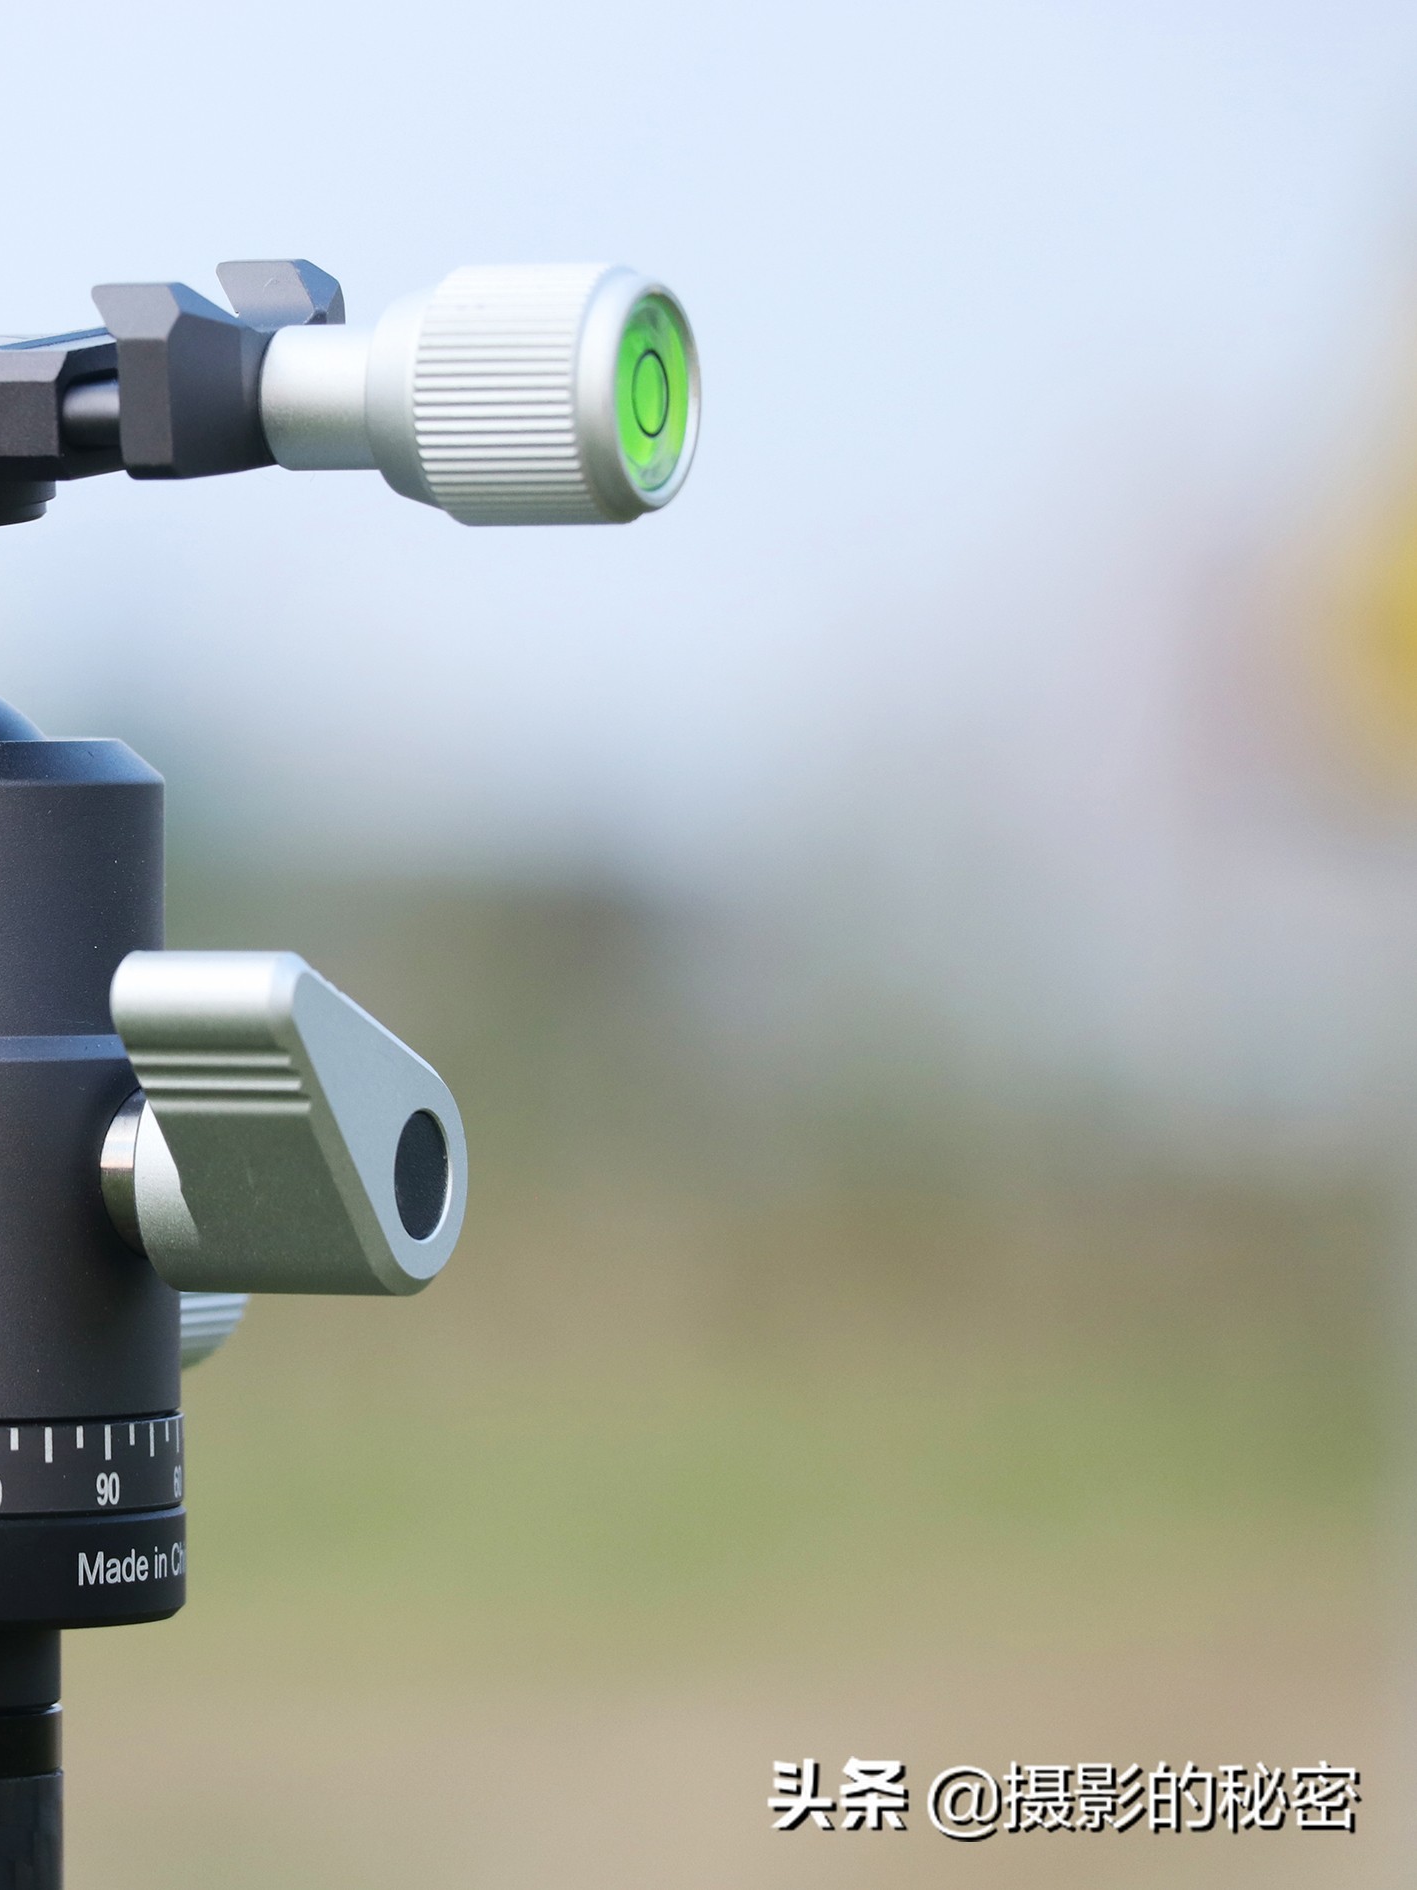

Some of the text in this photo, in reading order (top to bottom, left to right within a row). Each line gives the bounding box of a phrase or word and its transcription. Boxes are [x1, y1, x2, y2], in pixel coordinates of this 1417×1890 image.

[95, 1471, 120, 1506] 90
[78, 1548, 149, 1586] Made
[154, 1545, 168, 1579] in
